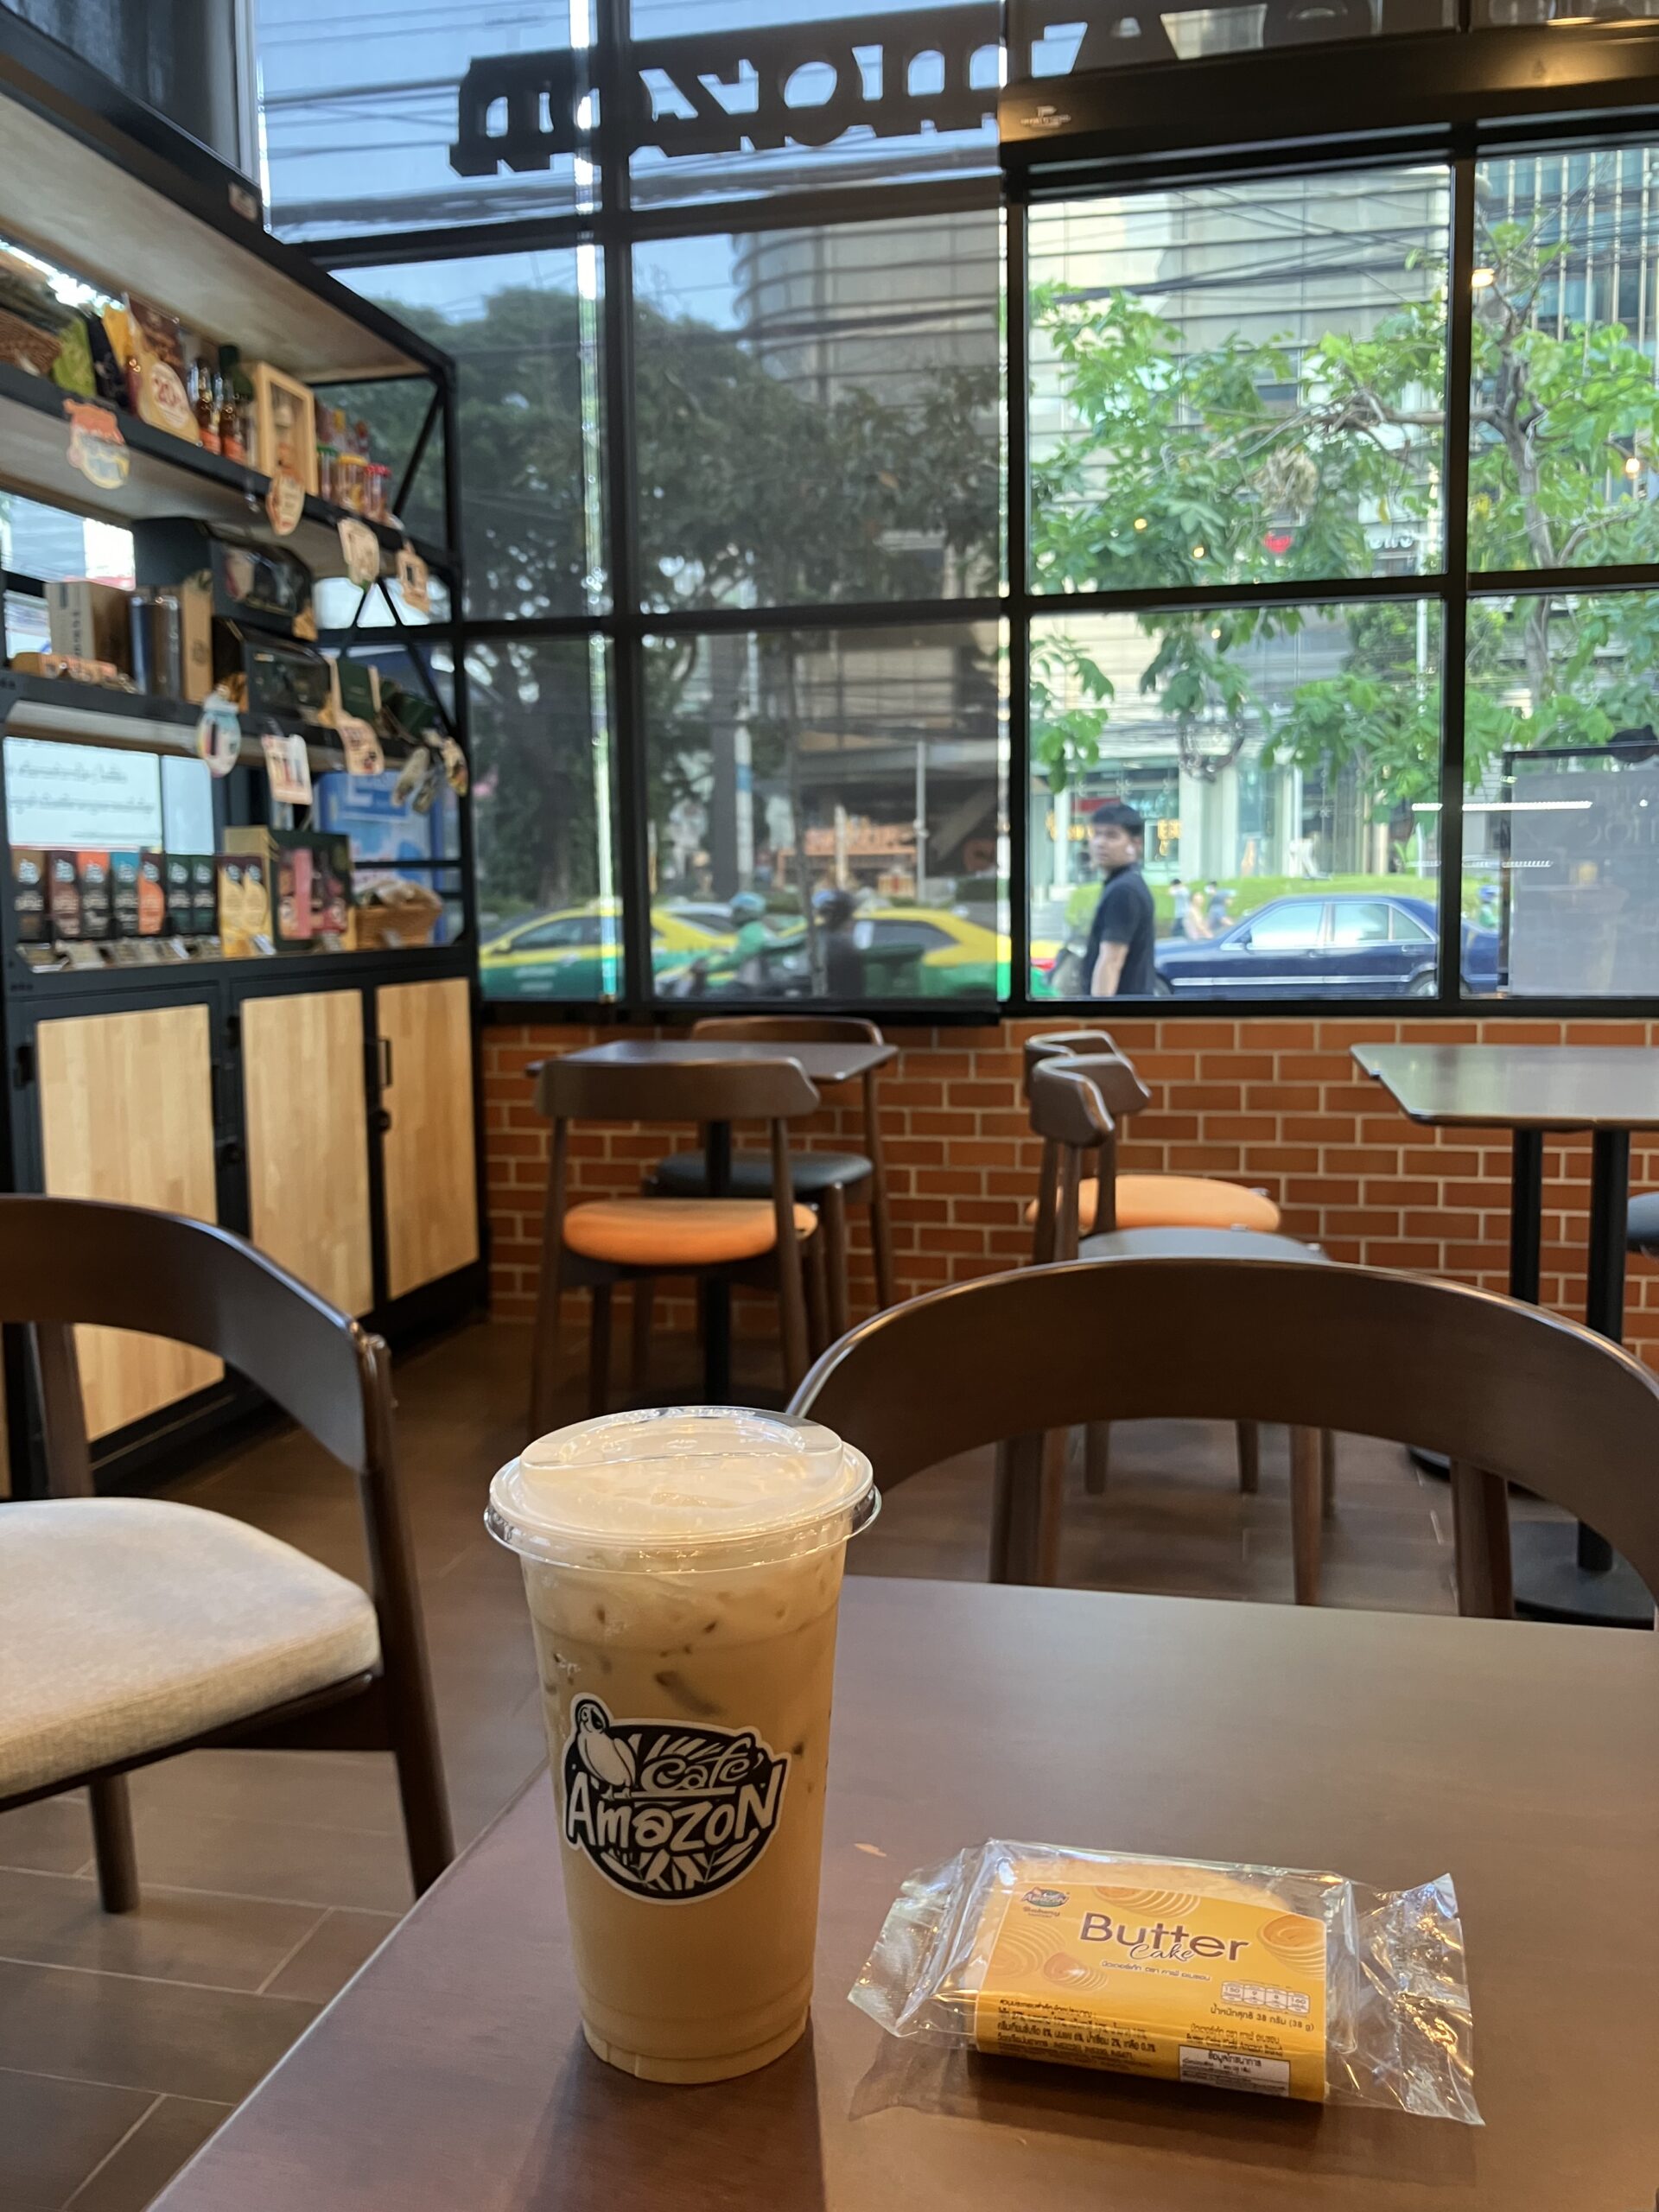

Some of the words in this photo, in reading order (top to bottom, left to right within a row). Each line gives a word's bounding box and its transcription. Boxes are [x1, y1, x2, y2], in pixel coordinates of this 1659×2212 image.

[1080, 1911, 1249, 1961] Butter
[1129, 1942, 1195, 1962] Cake
[1256, 2012, 1267, 2022] 38
